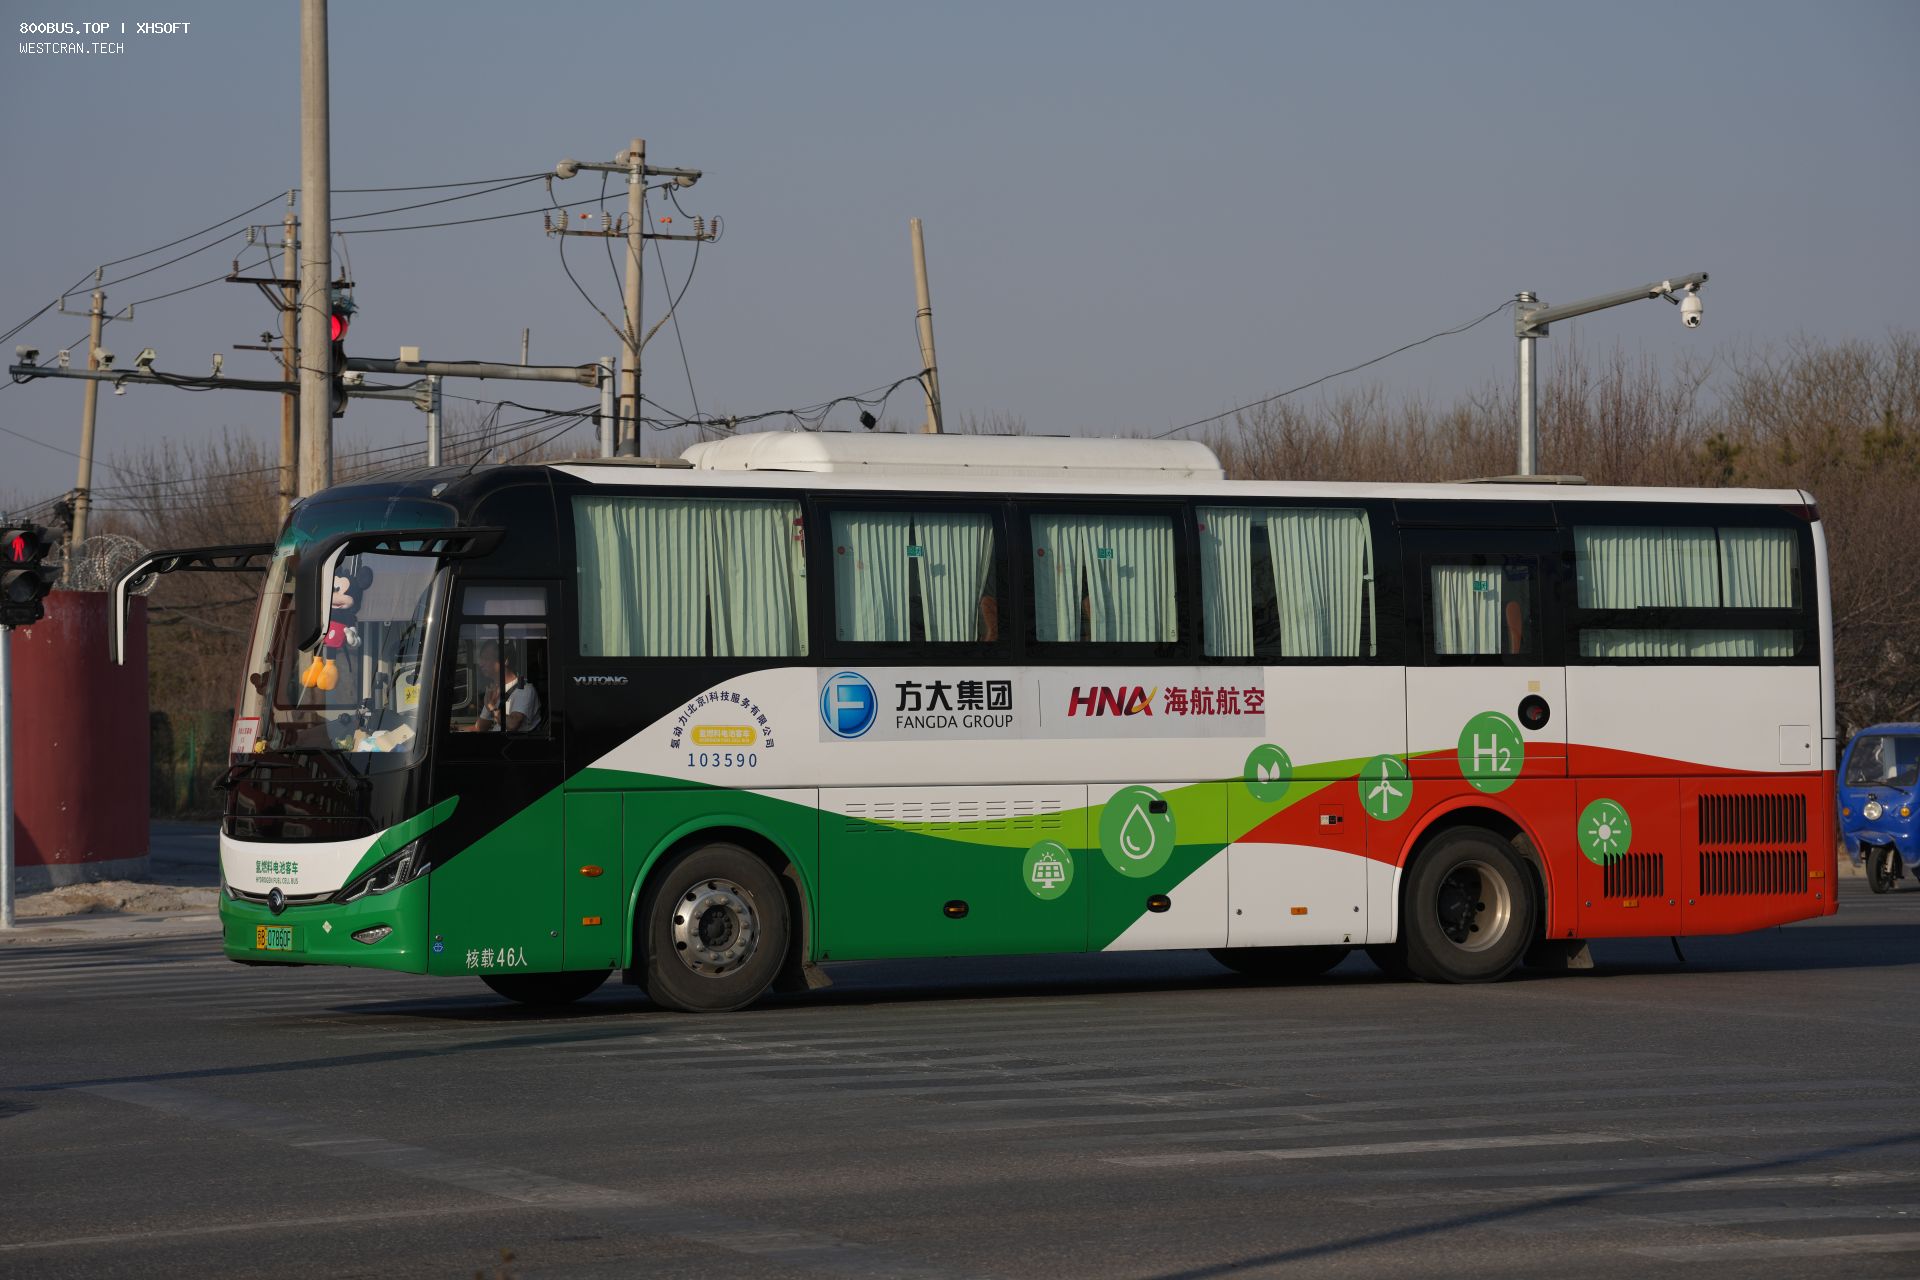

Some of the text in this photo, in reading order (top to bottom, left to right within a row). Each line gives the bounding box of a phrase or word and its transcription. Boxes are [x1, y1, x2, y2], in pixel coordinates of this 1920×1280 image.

[572, 676, 629, 686] YUTONG
[895, 680, 1013, 711] 方大集团
[1067, 685, 1158, 717] HNA
[1164, 686, 1265, 716] 海航航空
[896, 714, 1013, 729] FANGDA GROUP
[687, 752, 758, 768] 103590
[1473, 733, 1512, 772] H2
[465, 946, 528, 969] 核载46人
